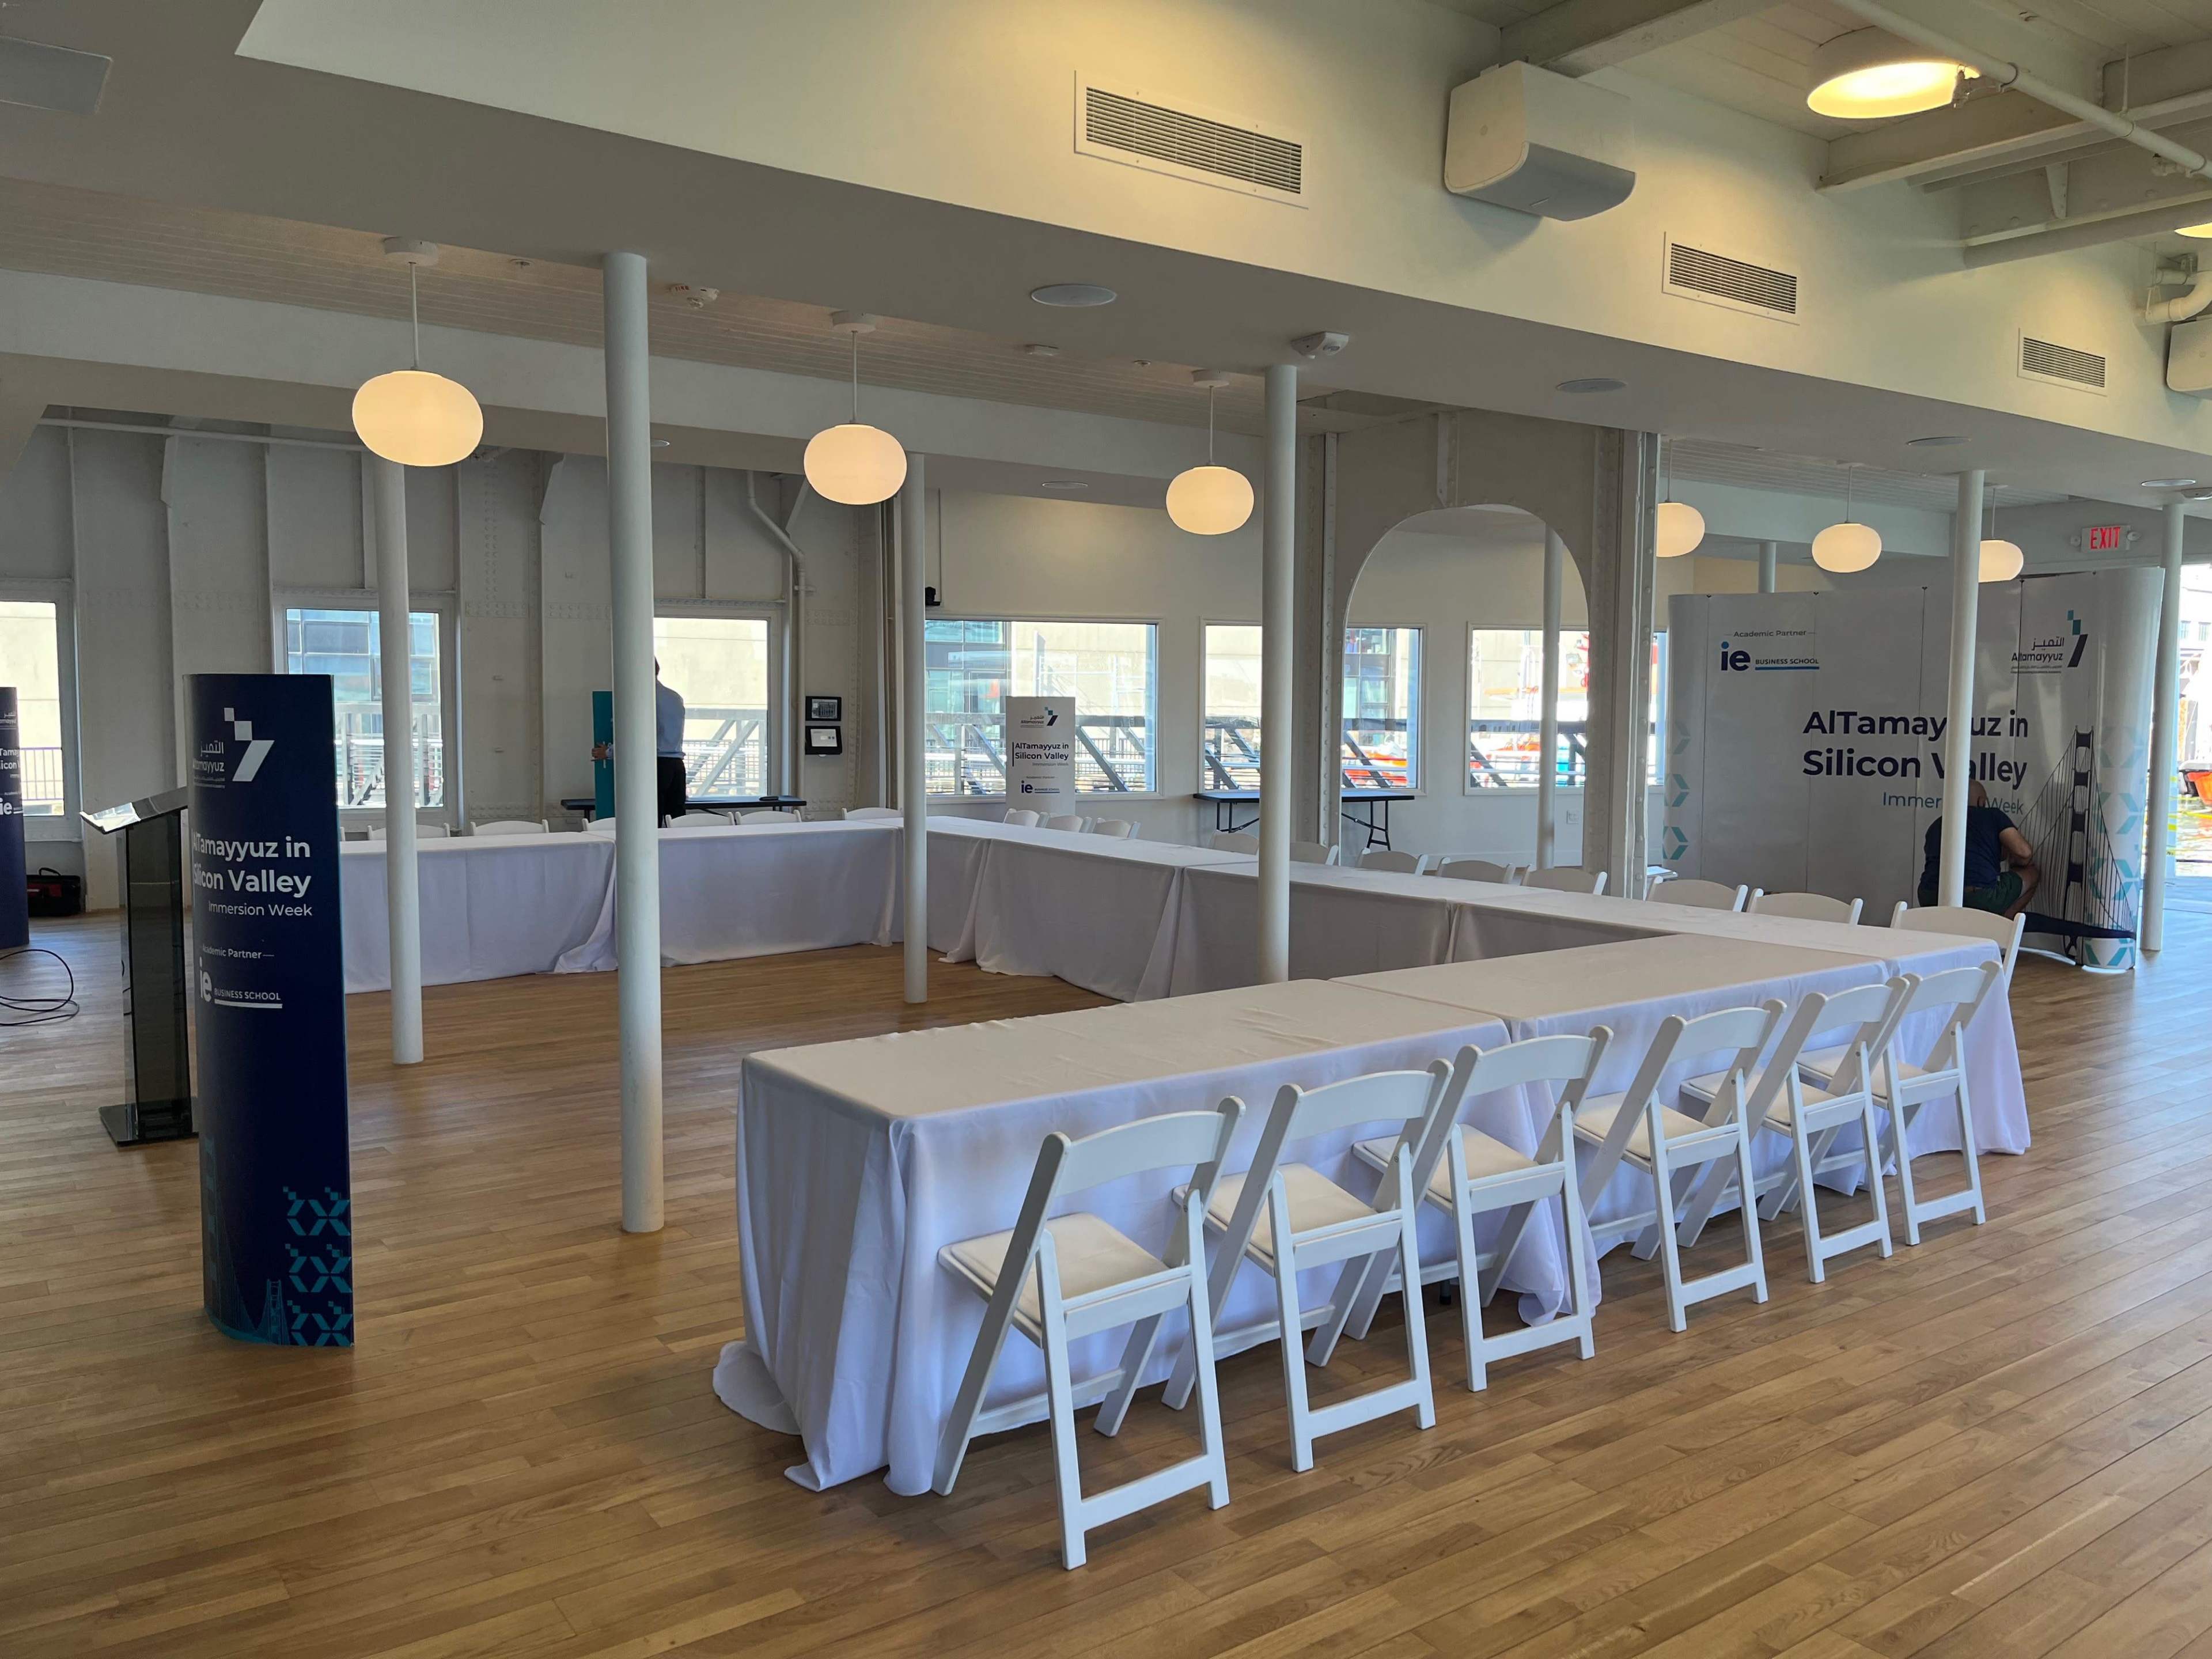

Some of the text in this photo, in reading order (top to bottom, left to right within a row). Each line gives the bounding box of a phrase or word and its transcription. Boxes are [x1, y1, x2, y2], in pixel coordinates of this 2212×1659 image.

[2090, 526, 2120, 549] EXIT
[2031, 636, 2065, 650] التميز
[1721, 641, 1751, 671] ie
[1802, 709, 2028, 741] AlTamayuz in
[1015, 743, 1061, 751] AlTamayyuz
[1044, 752, 1069, 761] Valley
[1802, 748, 1921, 778] Silicon
[1021, 780, 1033, 793] ie
[1986, 796, 2024, 815] Week
[285, 835, 310, 858] in
[228, 869, 312, 898] Valley
[208, 900, 313, 916] Immersion Week
[228, 948, 262, 959] Partner
[199, 956, 281, 1002] ie BUSINESS SCHOOL
